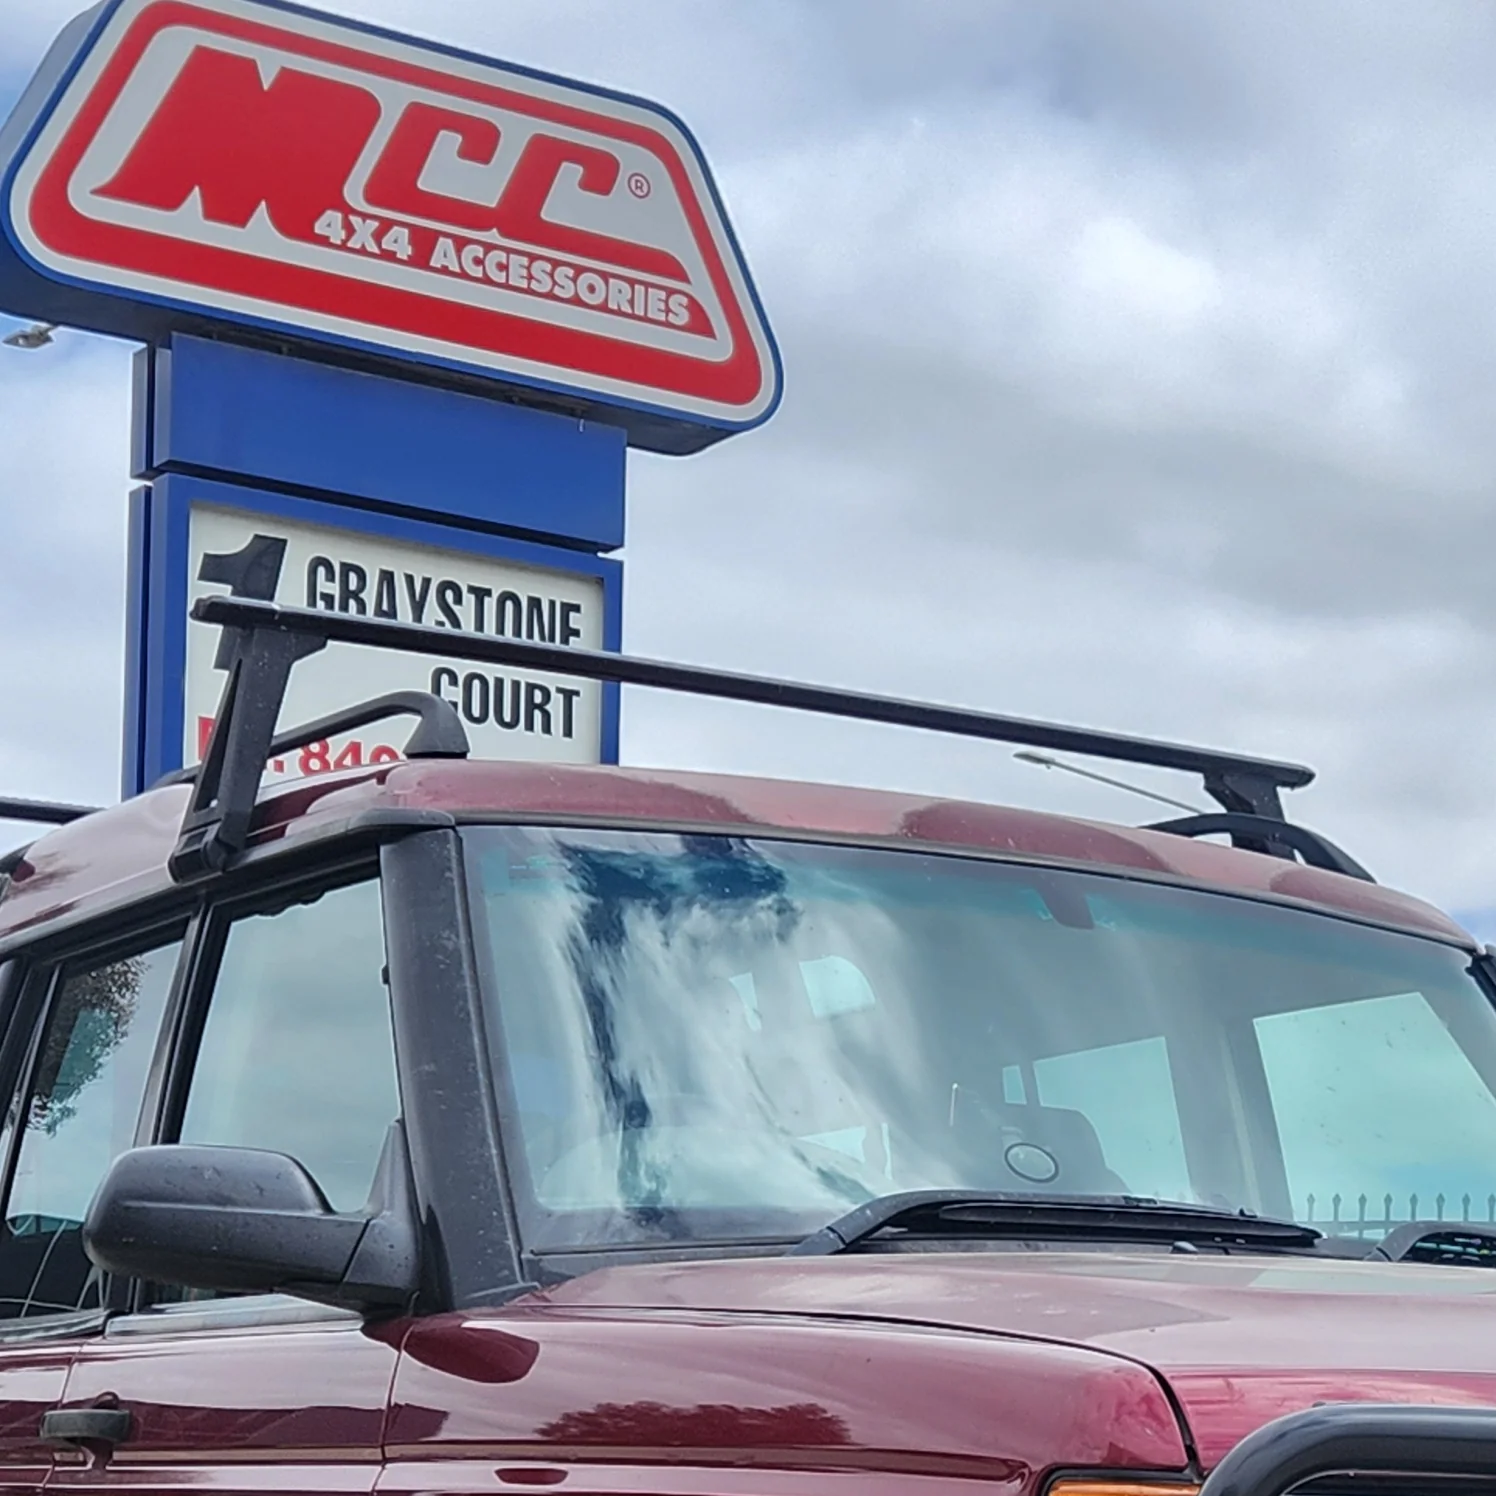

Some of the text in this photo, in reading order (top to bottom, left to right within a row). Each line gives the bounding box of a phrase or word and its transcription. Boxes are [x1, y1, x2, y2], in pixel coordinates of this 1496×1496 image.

[88, 44, 694, 284] MCC
[314, 209, 690, 325] 4X4 ACCESSORIES
[307, 556, 582, 646] GRAYSTONE
[431, 667, 581, 738] COURT
